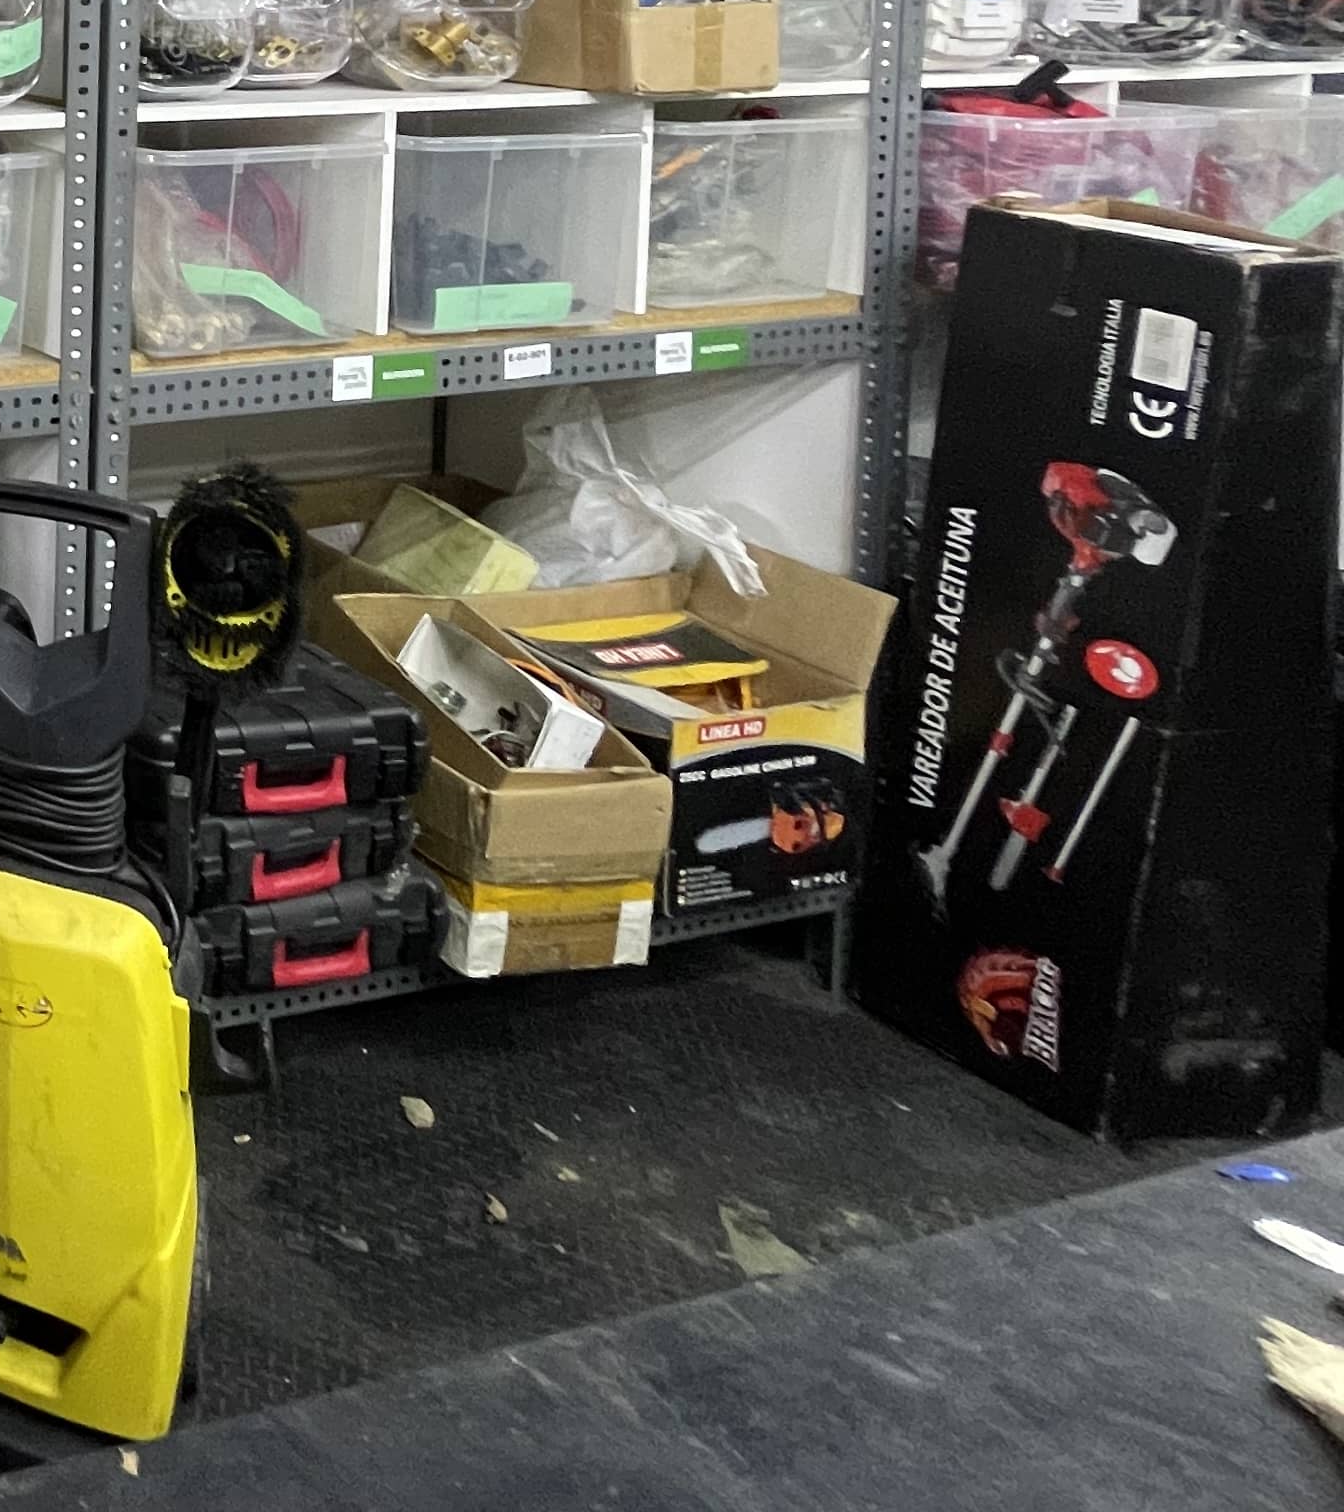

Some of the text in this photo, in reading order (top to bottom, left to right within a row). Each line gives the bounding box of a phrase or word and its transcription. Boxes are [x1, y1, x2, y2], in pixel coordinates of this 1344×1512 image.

[700, 719, 764, 741] LINEA HD
[908, 506, 978, 808] VAREADOR DE ACEITUNA
